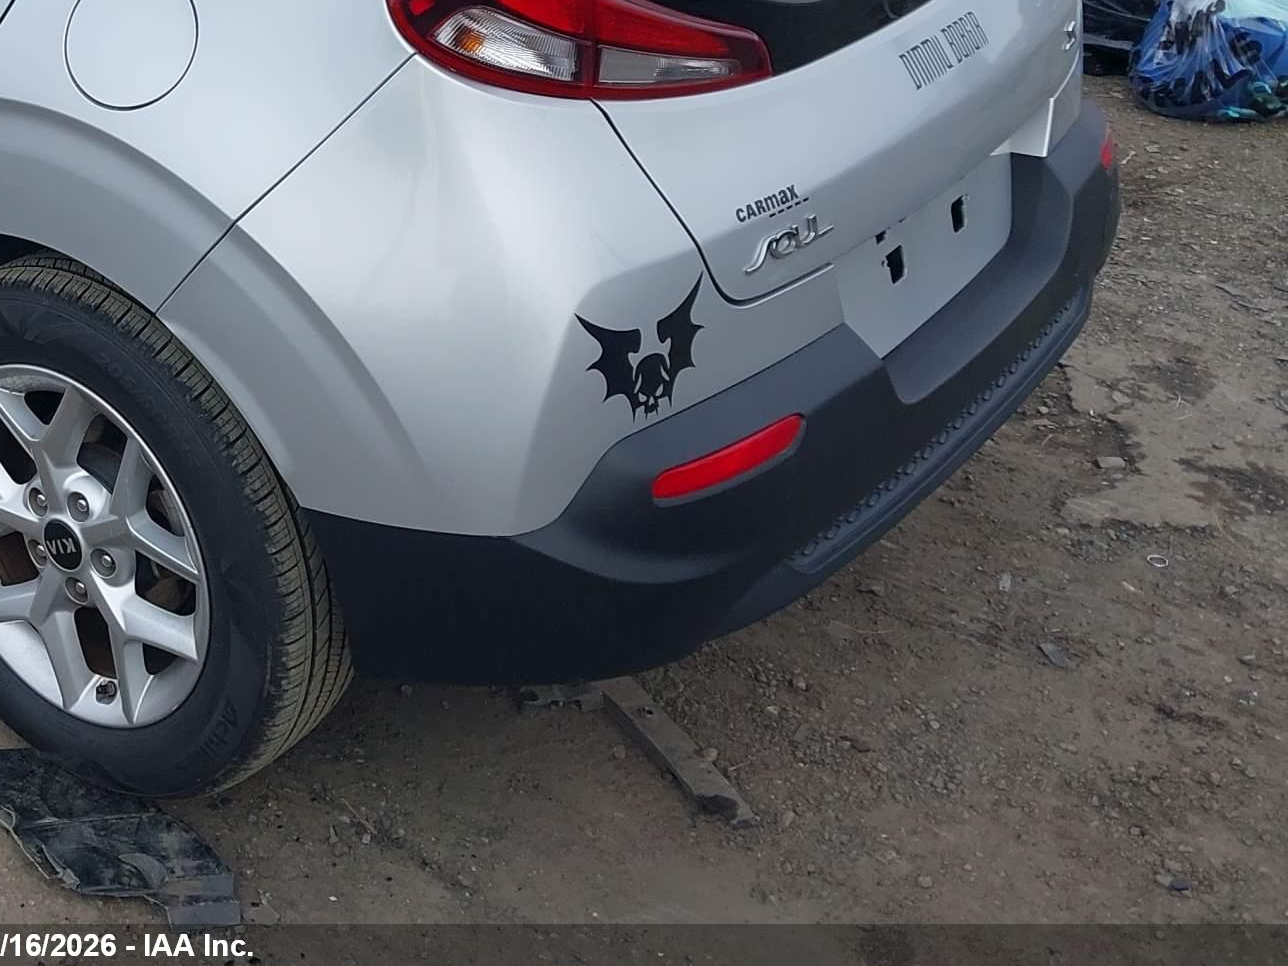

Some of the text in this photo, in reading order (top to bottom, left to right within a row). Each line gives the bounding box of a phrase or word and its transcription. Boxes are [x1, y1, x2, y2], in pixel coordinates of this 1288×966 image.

[899, 10, 990, 91] DIMMU BORGIR
[743, 213, 834, 275] SOUL
[46, 537, 77, 555] KIA
